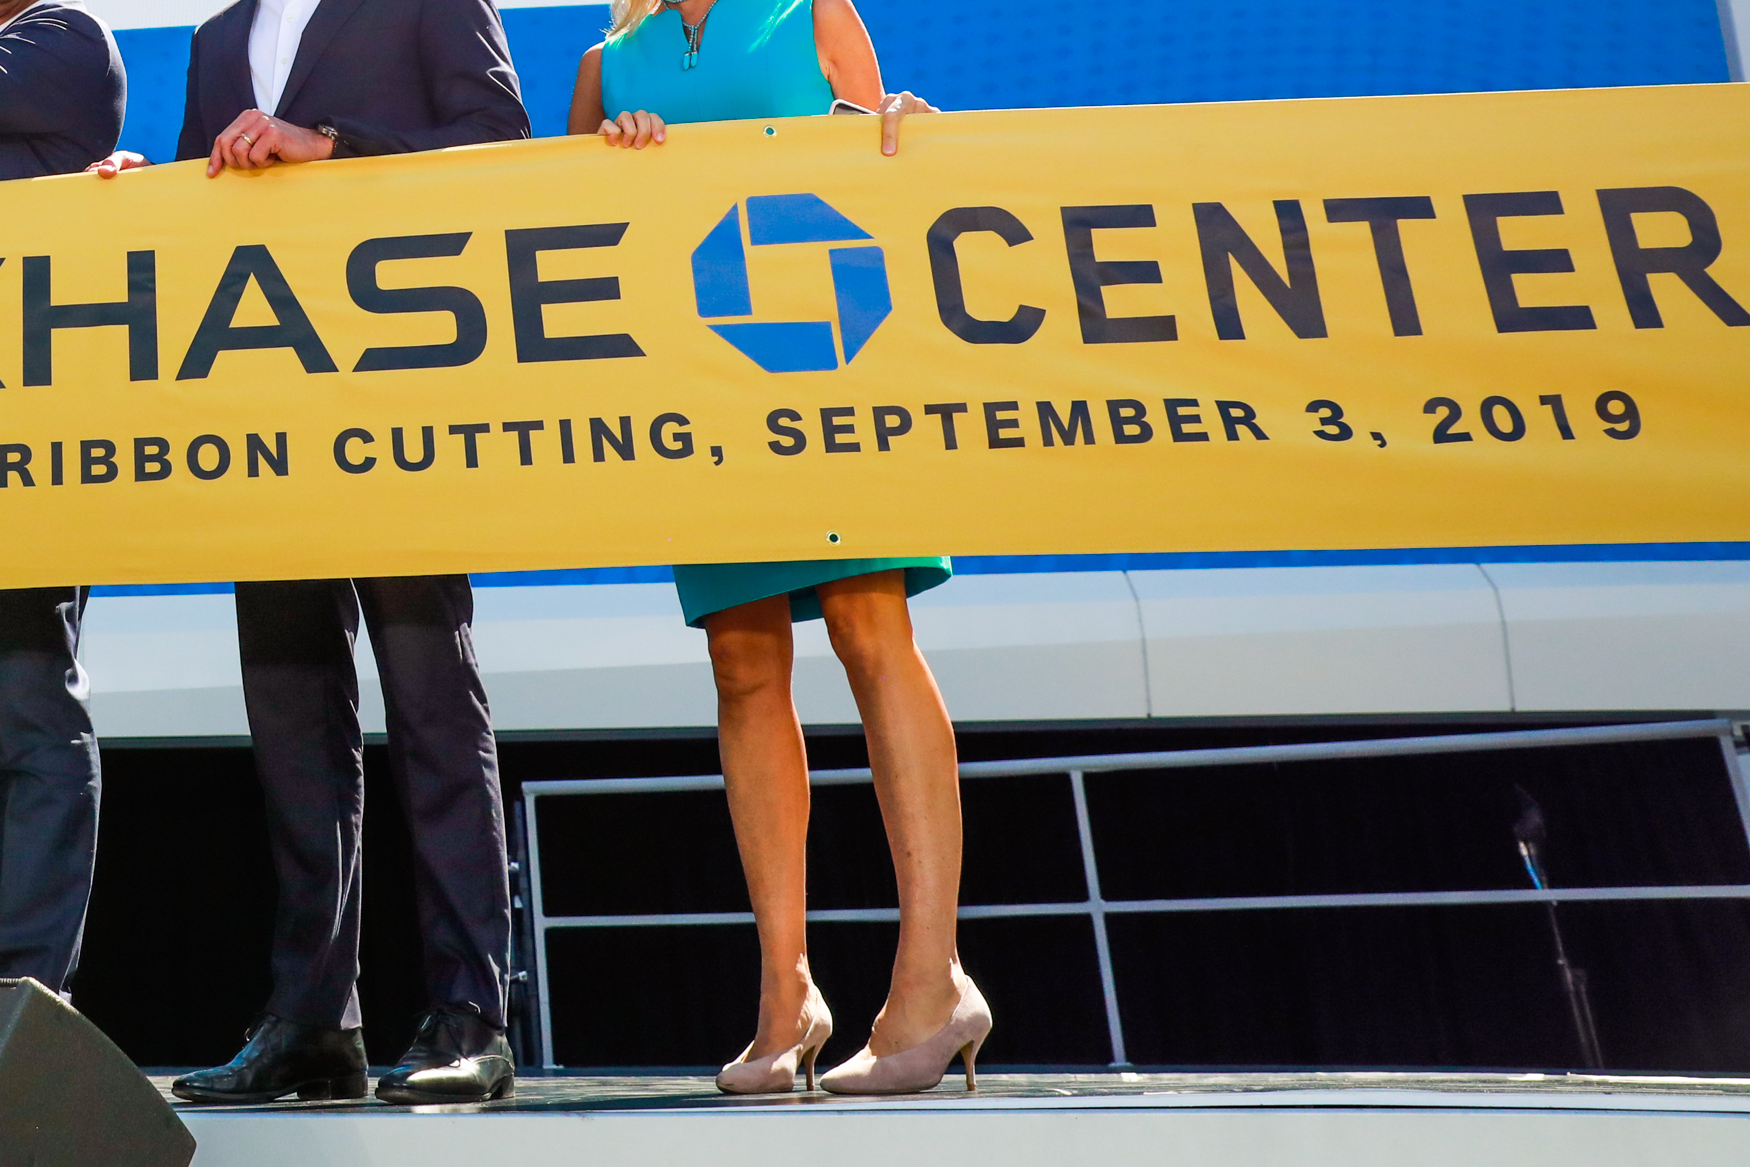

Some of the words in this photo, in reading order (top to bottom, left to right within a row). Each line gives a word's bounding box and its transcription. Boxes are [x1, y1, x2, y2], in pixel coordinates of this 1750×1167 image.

[925, 185, 1750, 345] CENTER
[333, 412, 725, 475] CUTTING,
[765, 397, 1270, 457] SEPTEMBER
[1305, 398, 1388, 450] 3,
[1421, 390, 1643, 445] 2019
